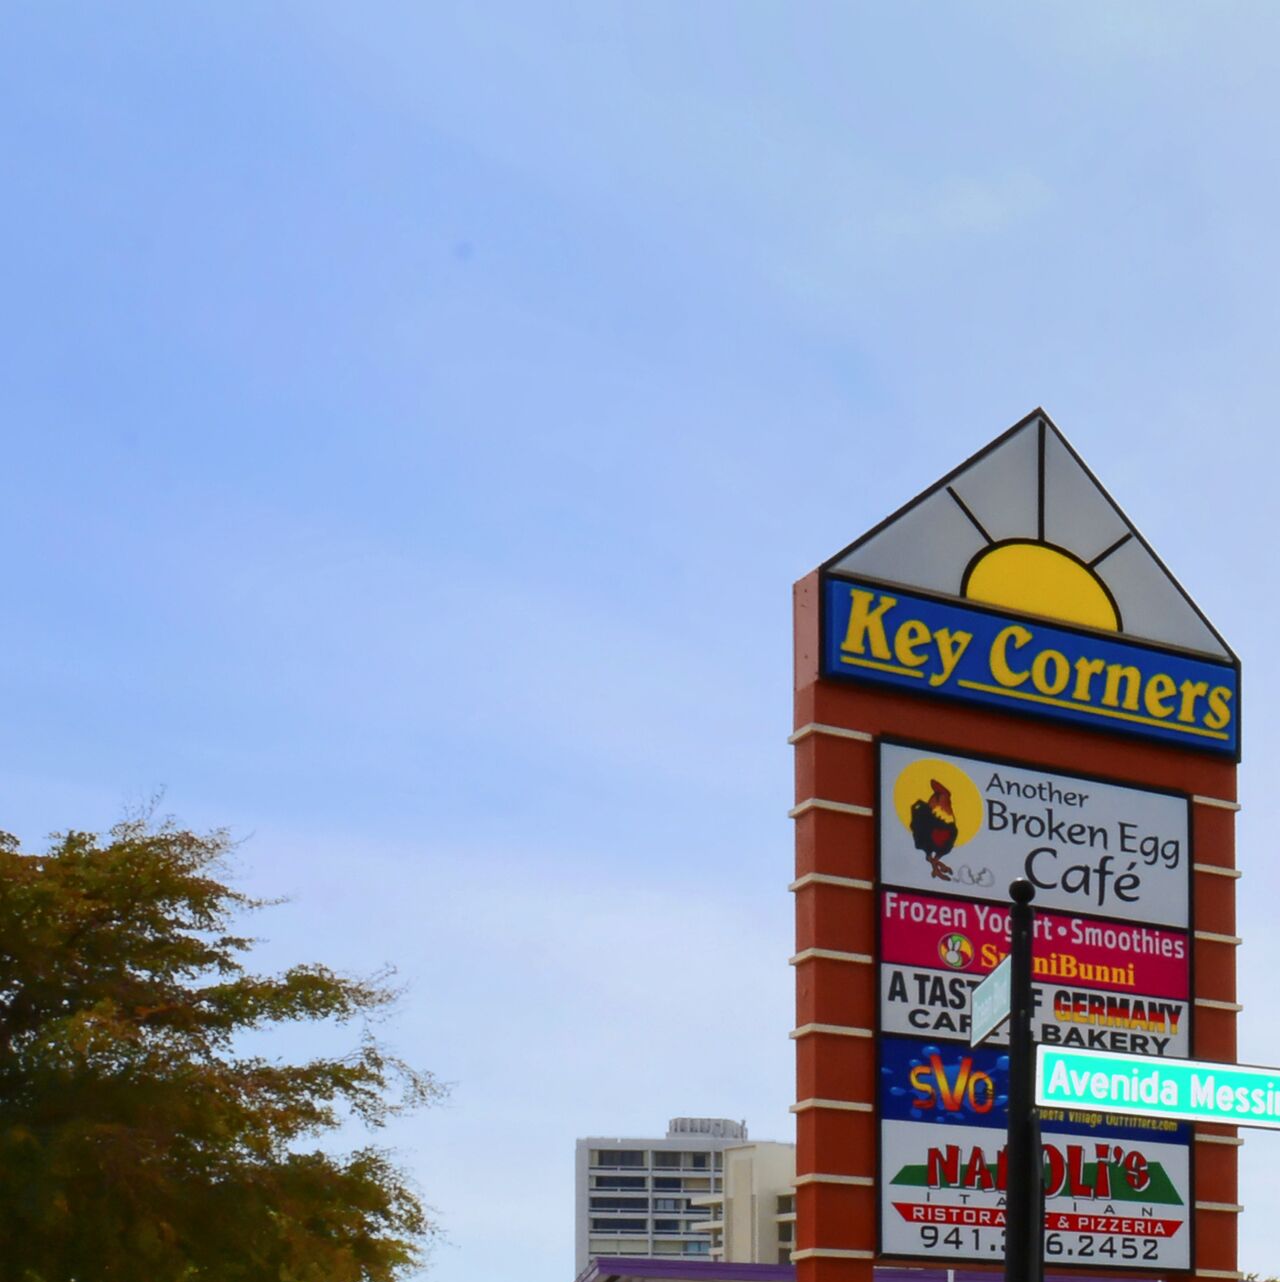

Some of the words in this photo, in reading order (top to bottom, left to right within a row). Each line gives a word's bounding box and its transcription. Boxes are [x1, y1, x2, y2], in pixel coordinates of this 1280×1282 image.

[840, 589, 973, 687] Key
[989, 625, 1233, 729] Corners
[985, 772, 1089, 808] Another
[986, 799, 1108, 851] Broken
[1118, 822, 1180, 868] Egg
[1024, 846, 1141, 907] Café
[885, 892, 967, 929] Frozen
[974, 905, 1052, 942] Yogrt
[1071, 919, 1185, 959] Smoothies
[888, 971, 909, 1004] A
[1054, 989, 1182, 1035] GERMANY
[1042, 1024, 1170, 1055] BAKERY
[1048, 1060, 1178, 1107] Avenida
[912, 1206, 1050, 1230] RISTORA
[1057, 1215, 1070, 1229] &
[1078, 1218, 1166, 1236] PIZZERIA
[926, 1191, 1153, 1217] ITAIAN
[920, 1225, 1159, 1261] 941.6.2452
